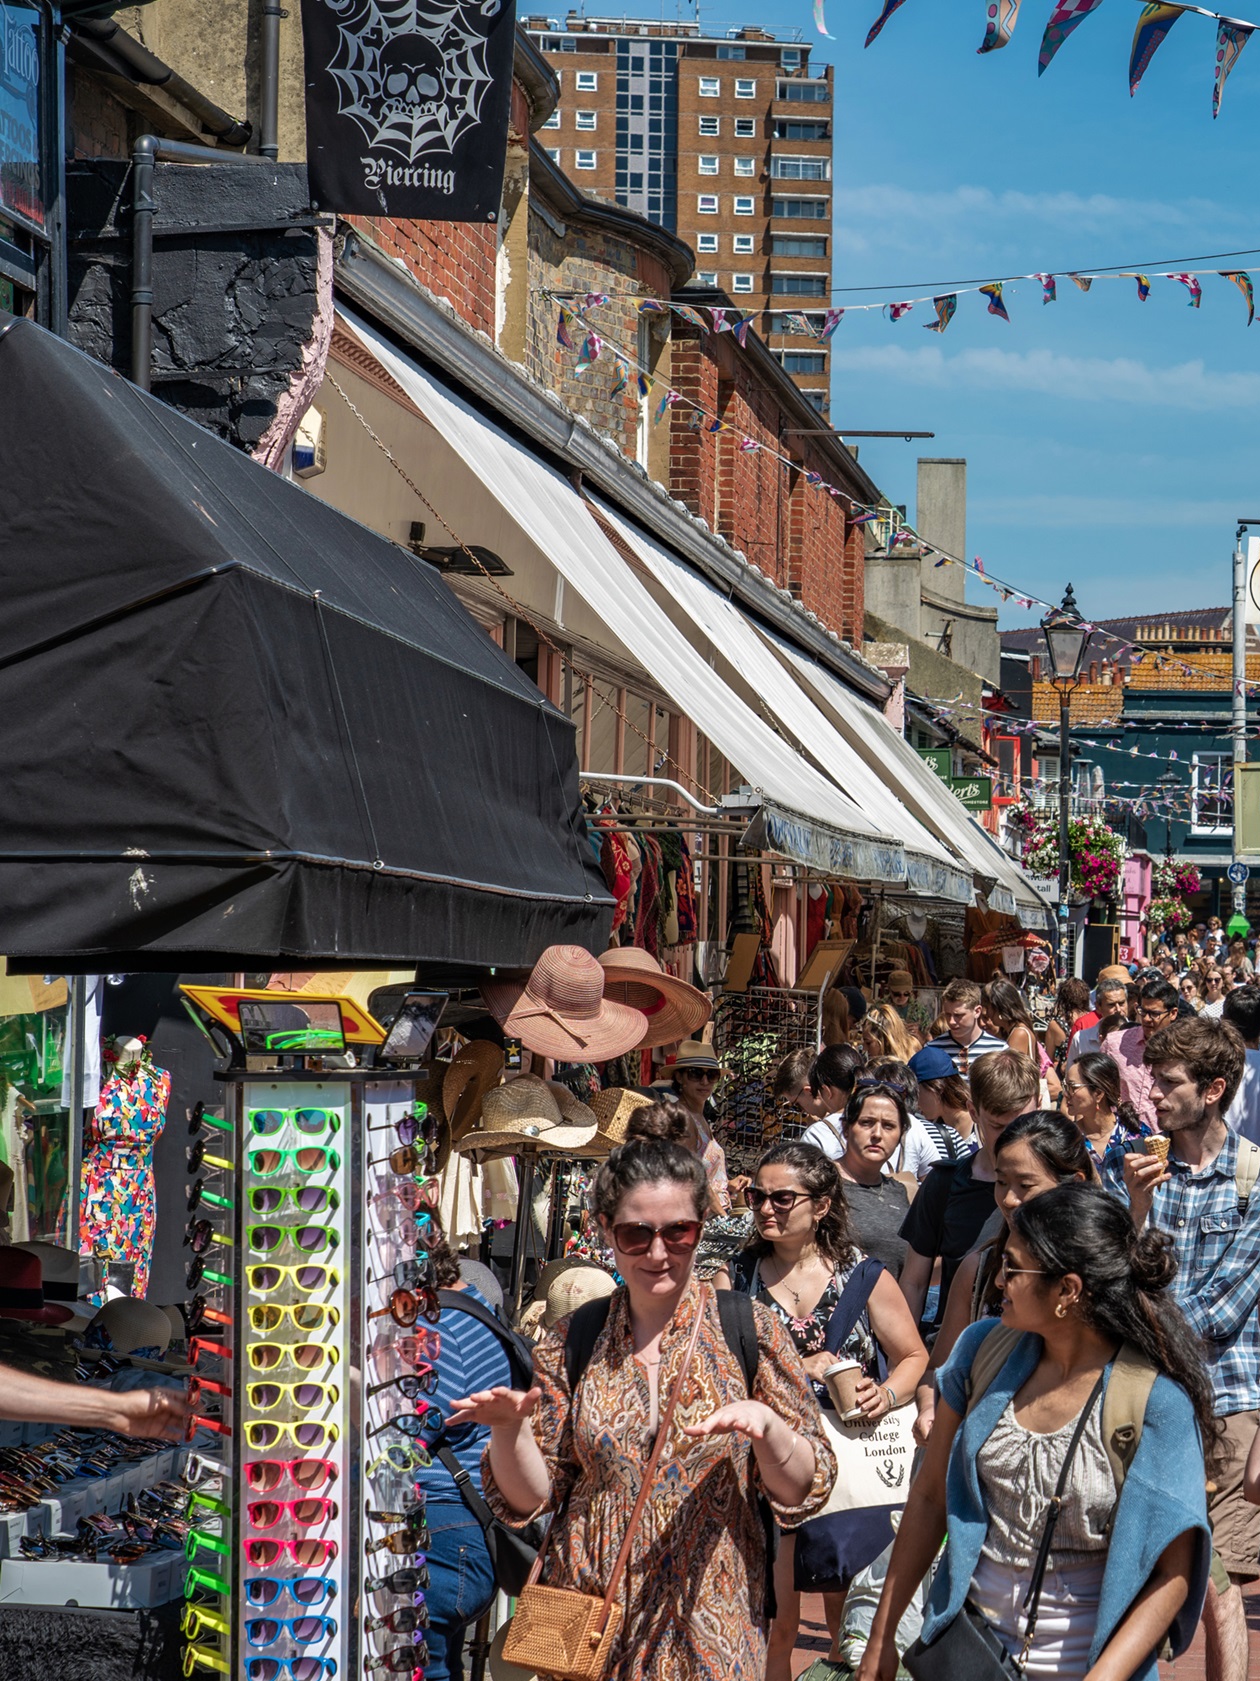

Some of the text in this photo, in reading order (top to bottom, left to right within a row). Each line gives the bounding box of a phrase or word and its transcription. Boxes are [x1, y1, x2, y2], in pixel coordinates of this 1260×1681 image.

[2, 6, 39, 86] Tattoo
[360, 157, 456, 194] Piercing
[950, 783, 981, 801] ert's
[1036, 885, 1051, 893] tall
[844, 1416, 901, 1429] University
[859, 1431, 900, 1443] College
[864, 1445, 906, 1457] London
